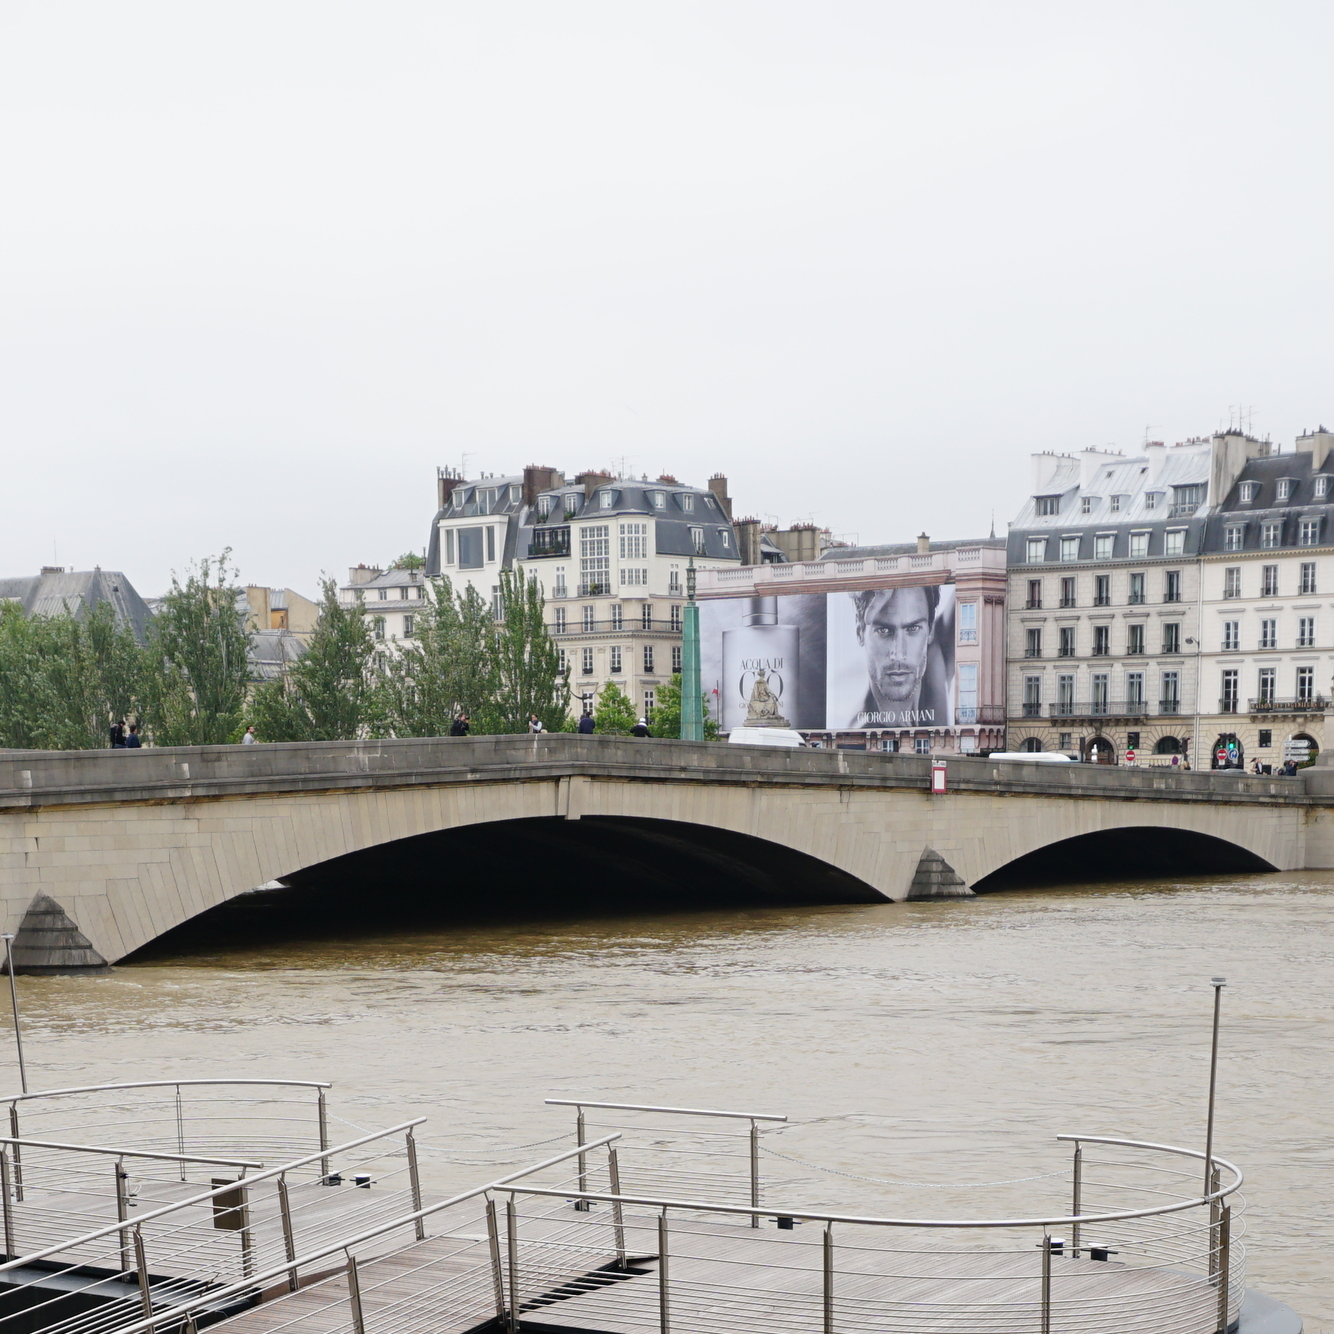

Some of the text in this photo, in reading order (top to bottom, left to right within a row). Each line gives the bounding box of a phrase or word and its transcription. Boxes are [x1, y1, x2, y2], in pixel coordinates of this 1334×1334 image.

[740, 658, 784, 670] ACQUA DI
[857, 709, 935, 723] GIORGIO ARMANI
